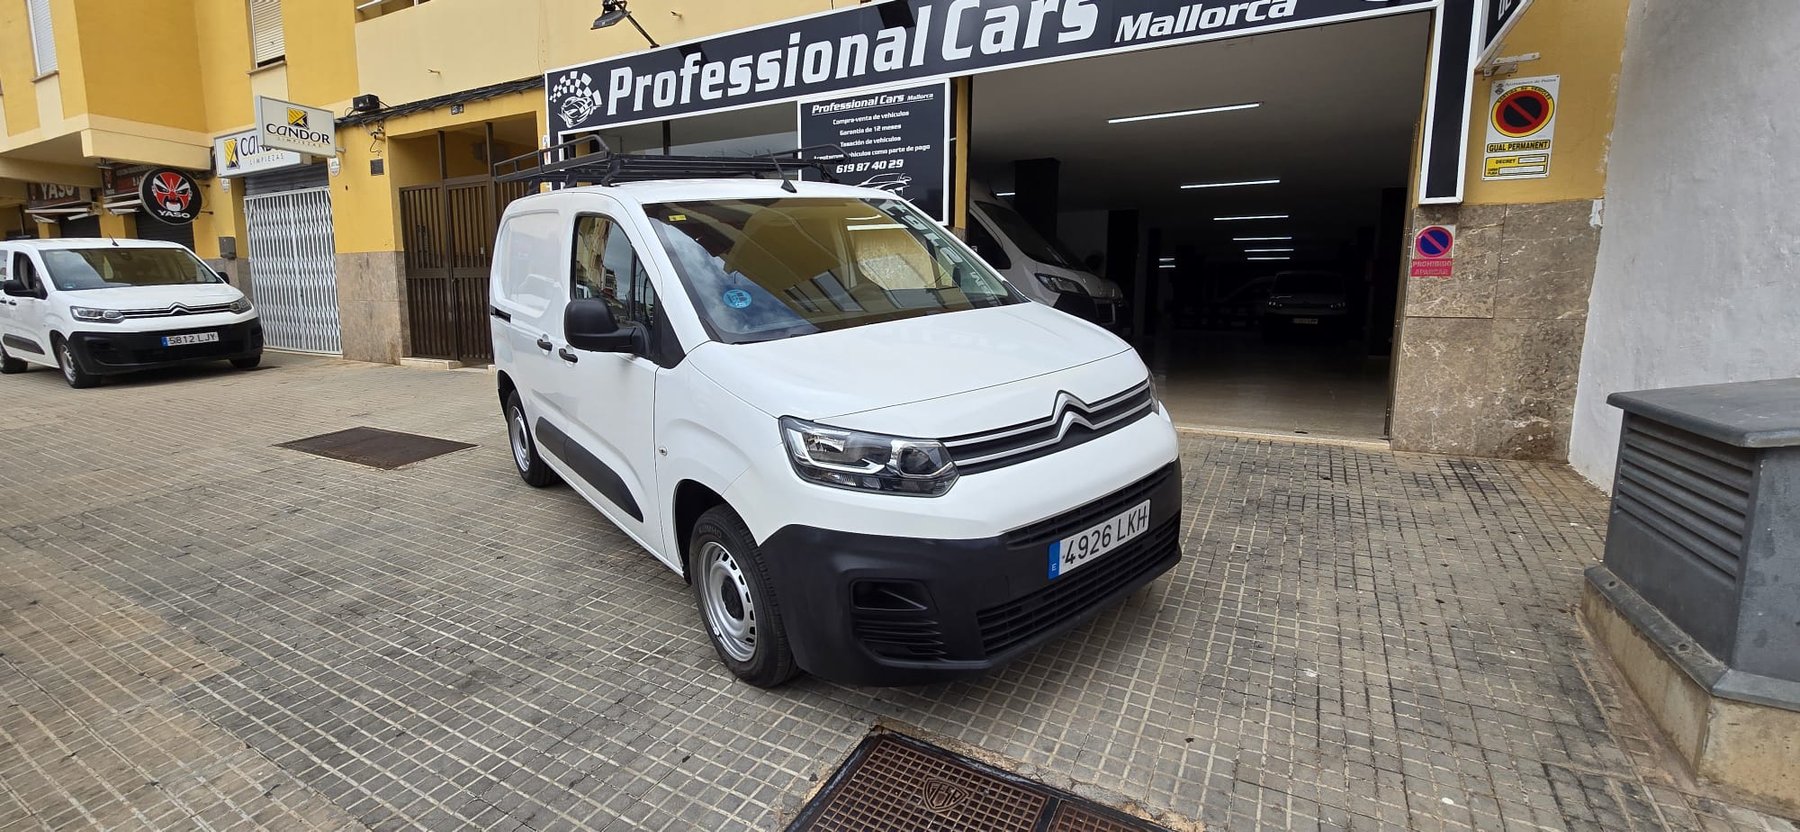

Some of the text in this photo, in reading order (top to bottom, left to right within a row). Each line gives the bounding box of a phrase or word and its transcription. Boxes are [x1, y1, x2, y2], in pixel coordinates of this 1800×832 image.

[607, 0, 1300, 116] Professional Cars Mallorca
[812, 93, 934, 114] Professional Cars Mallorca
[888, 146, 905, 155] parte
[914, 144, 930, 152] pago
[1489, 141, 1549, 152] GUAL PERMANENT
[250, 153, 284, 165] LIMPIEZAS
[836, 159, 904, 174] 619 87 40 29
[157, 210, 191, 219] YASO
[1412, 260, 1452, 268] PROHIBIDO
[169, 333, 216, 345] 5812 LJY
[1062, 505, 1147, 564] 4926 LKH
